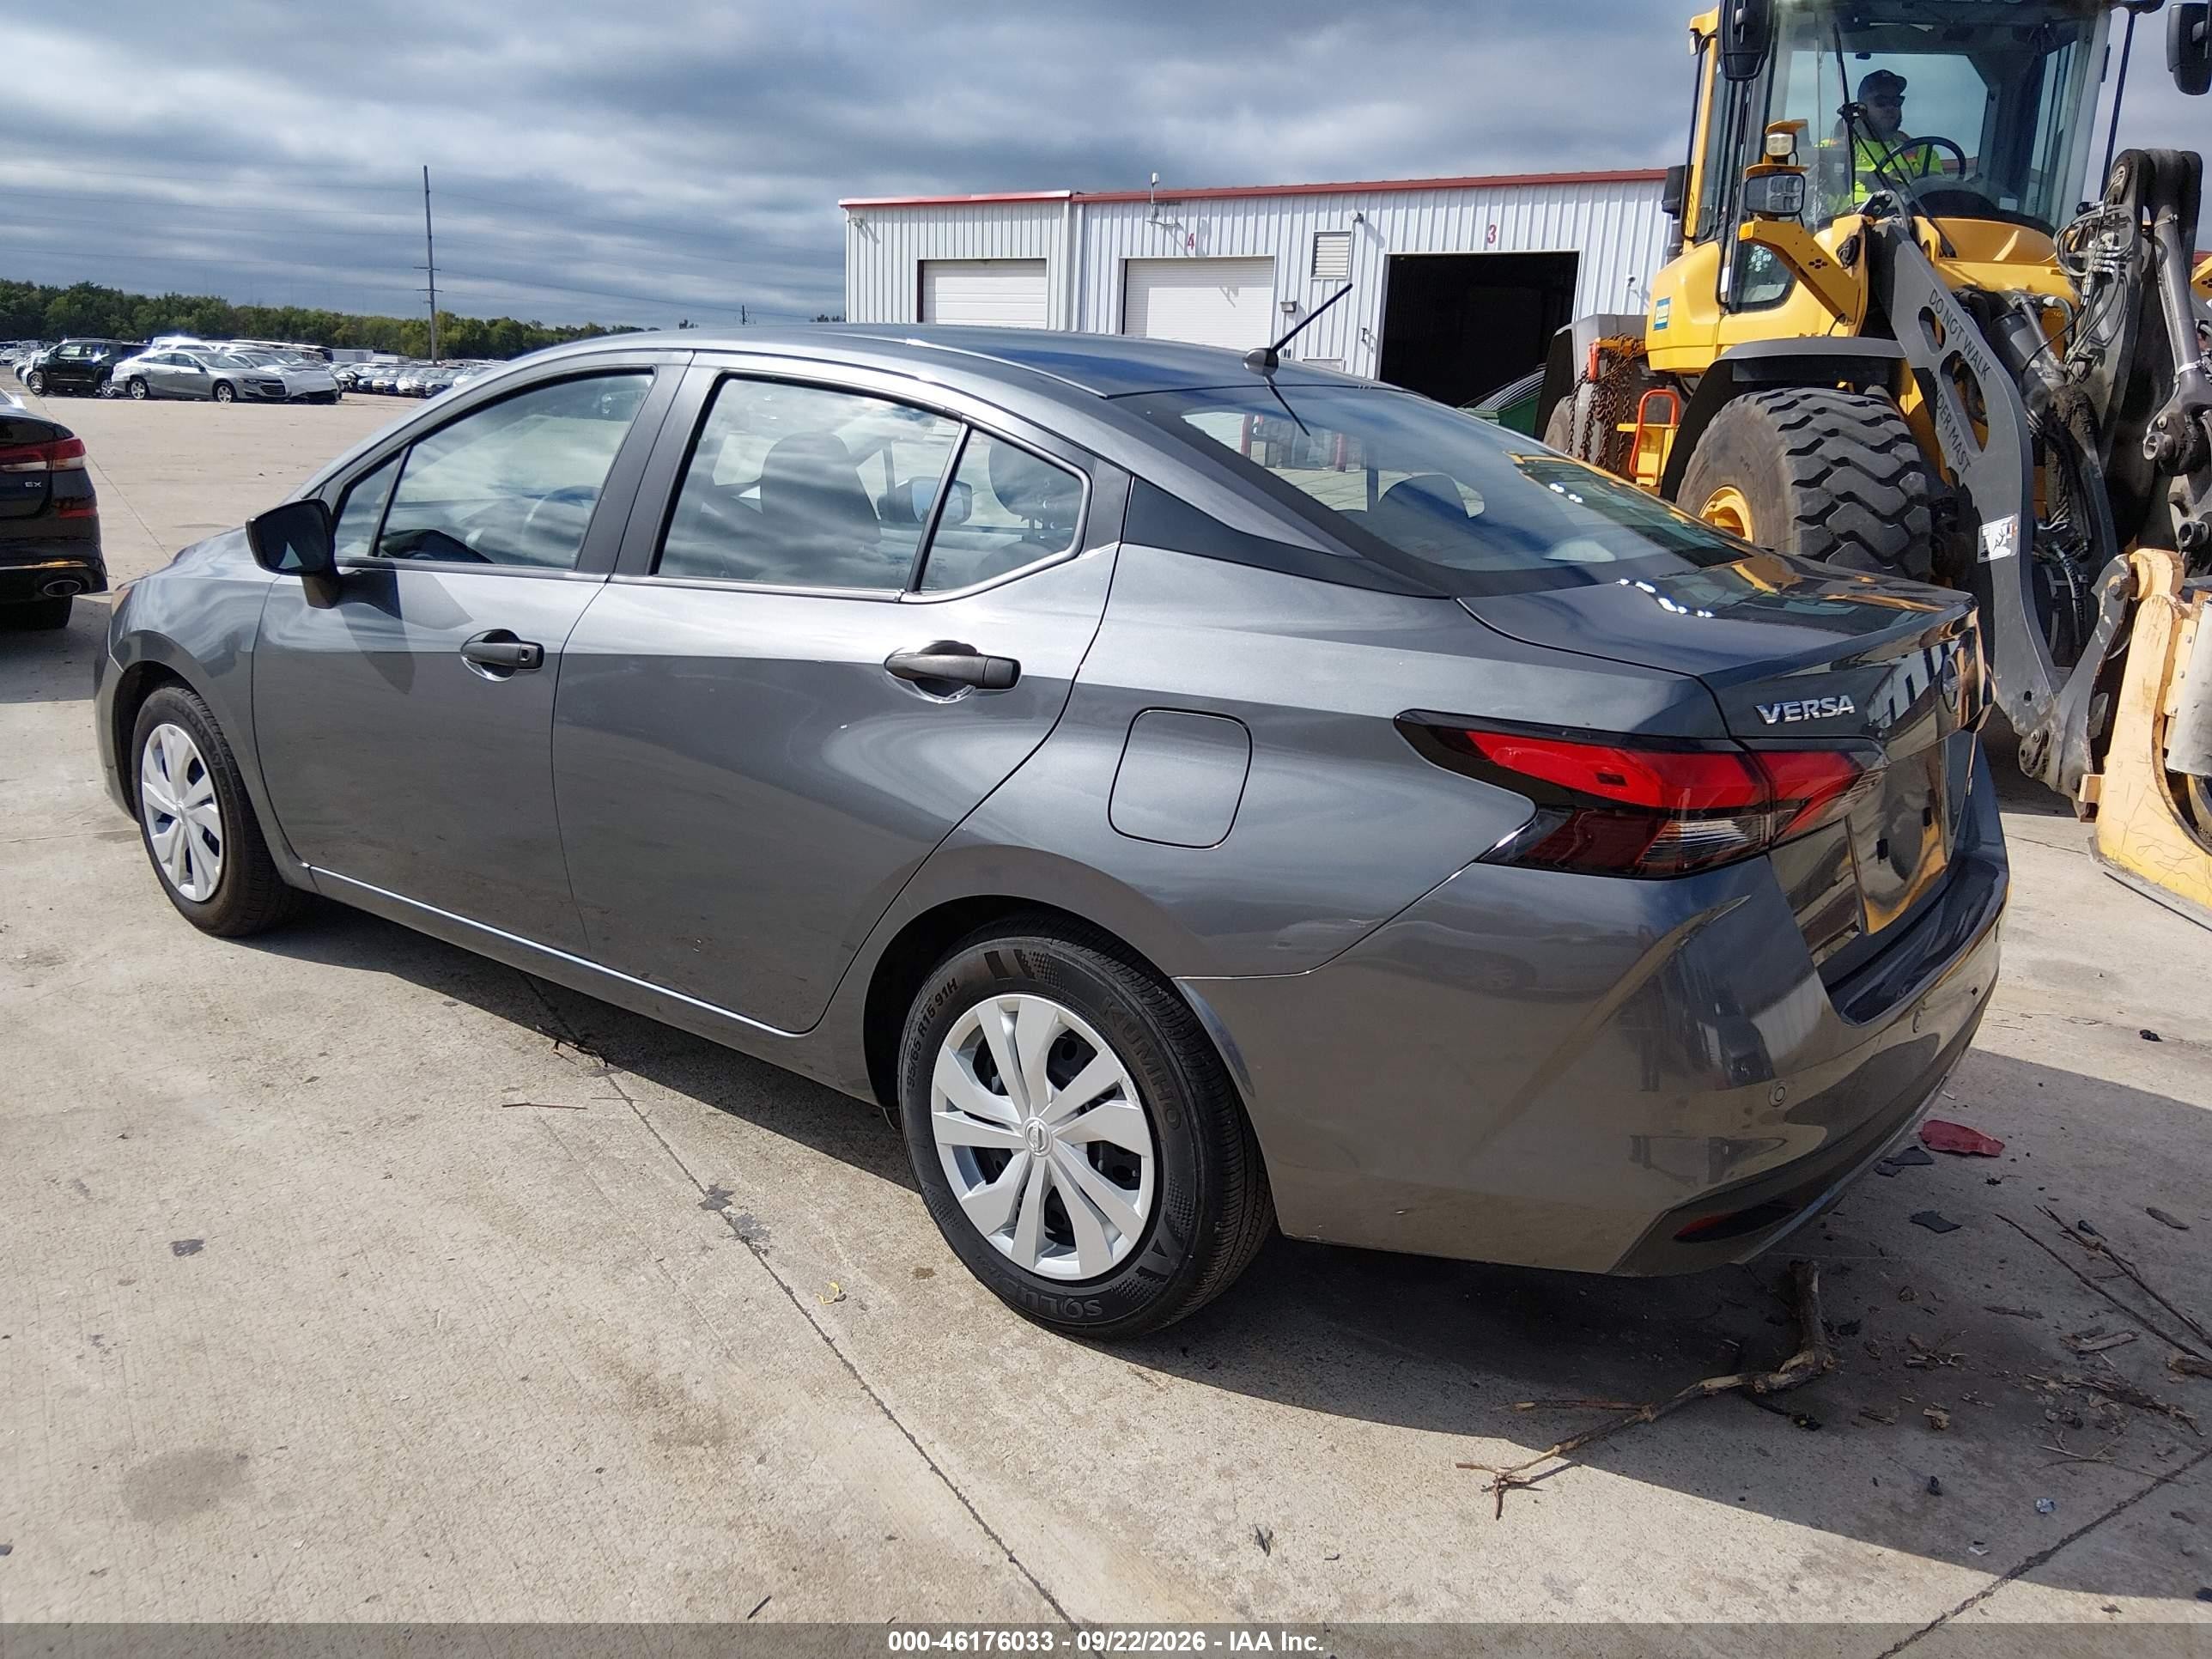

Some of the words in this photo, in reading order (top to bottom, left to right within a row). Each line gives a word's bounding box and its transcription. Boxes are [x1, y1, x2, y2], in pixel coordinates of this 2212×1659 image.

[1187, 233, 1194, 250] 4
[1487, 224, 1497, 244] 3
[1929, 289, 1944, 314] DO
[1942, 308, 1965, 341] NOT
[1963, 336, 1991, 381] WALK
[1948, 426, 1972, 473] MAST
[1754, 695, 1856, 725] VERSA
[917, 1004, 937, 1038] R15
[935, 977, 959, 1006] 91H
[1102, 994, 1182, 1131] KUMHO
